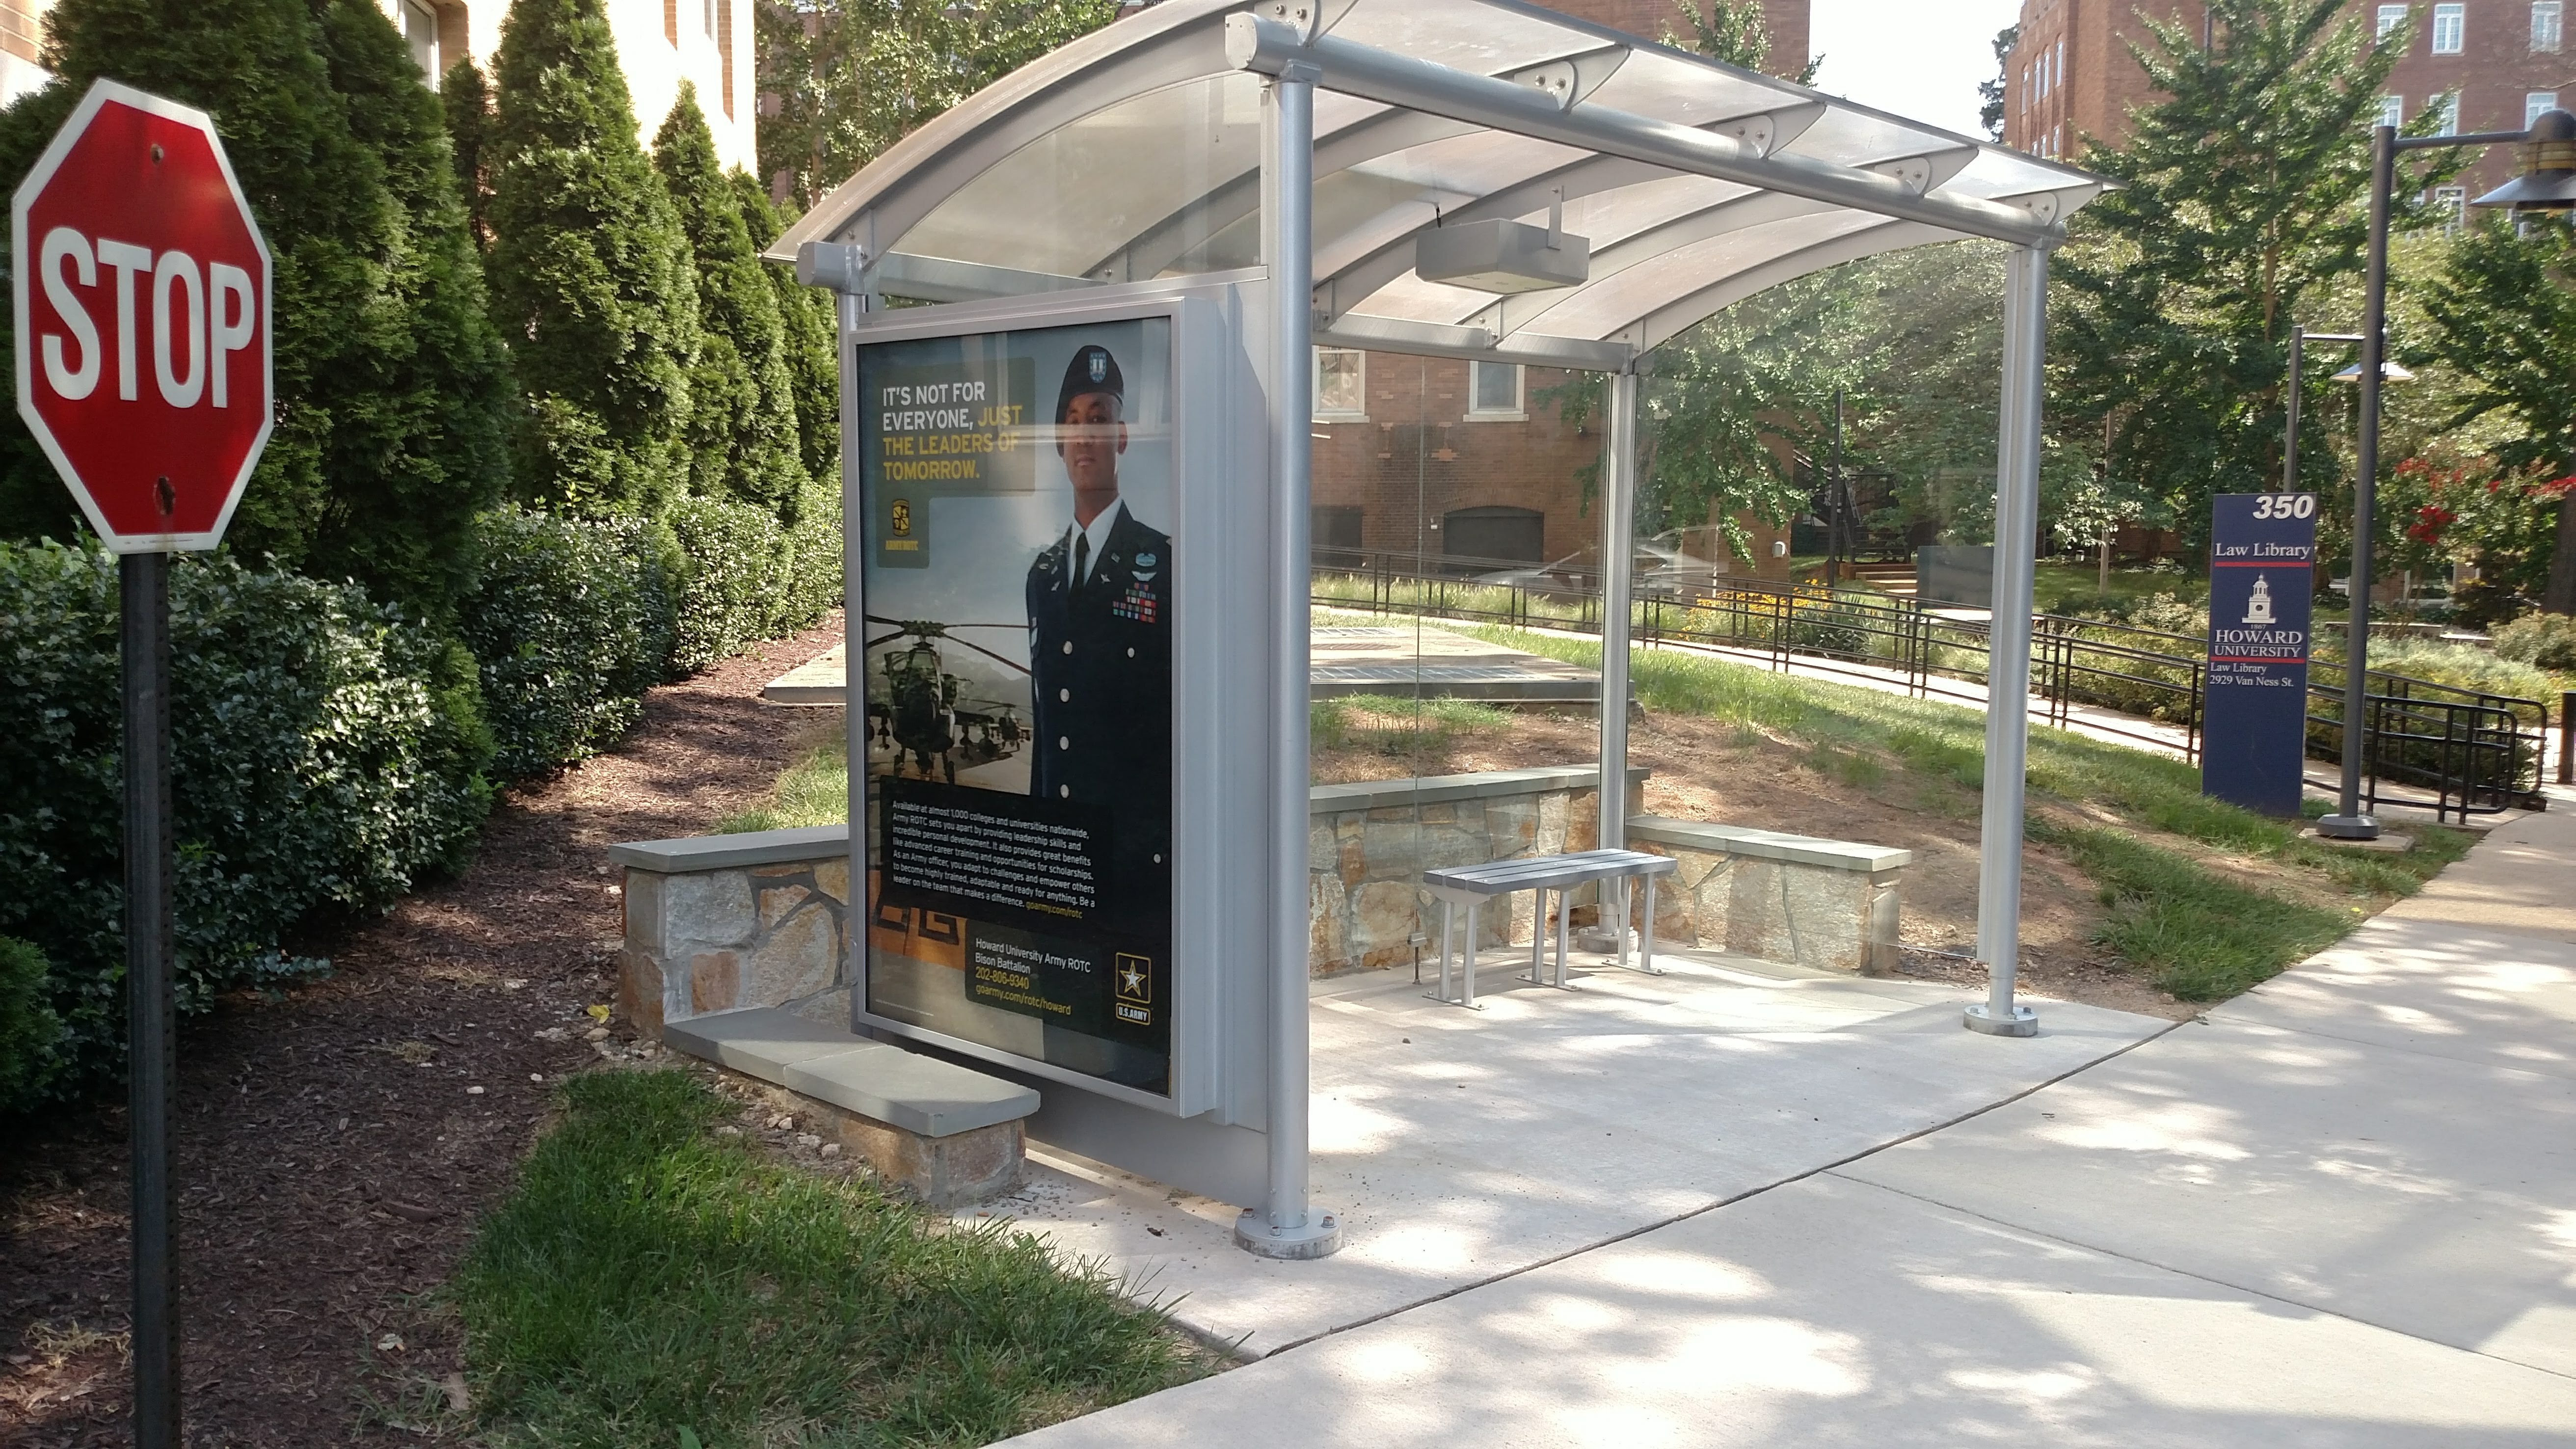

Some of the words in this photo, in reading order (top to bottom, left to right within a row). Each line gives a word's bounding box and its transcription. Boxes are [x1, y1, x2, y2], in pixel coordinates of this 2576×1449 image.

[41, 226, 256, 408] STOP
[884, 387, 911, 406] IT'S
[916, 384, 948, 404] NOT
[953, 381, 985, 402] FOR
[884, 408, 973, 431] EVERYONE,
[978, 405, 1022, 427] JUST
[883, 436, 914, 456] THE
[919, 433, 993, 455] LEADERS
[998, 432, 1020, 452] OF
[884, 460, 980, 481] TOMORROW.
[2253, 495, 2313, 519] 350
[2215, 543, 2249, 556] Law
[2253, 543, 2311, 560] Library
[2215, 629, 2303, 644] HOWARD
[2215, 645, 2301, 658] UNIVERSITY
[2209, 675, 2232, 685] 2929
[2235, 676, 2253, 685] Van
[2256, 677, 2279, 686] Ness
[2281, 677, 2294, 687] St.
[2210, 662, 2230, 672] Law
[2233, 663, 2267, 675] Library
[893, 800, 920, 812] Available
[929, 806, 950, 817] almost
[951, 809, 968, 819] 1,000
[970, 813, 995, 824] colleges
[996, 817, 1008, 826] and
[1010, 819, 1048, 832] universities
[1049, 826, 1089, 840] nationwide,
[893, 813, 908, 824] Army
[910, 815, 927, 826] ROTC
[929, 819, 942, 828] sets
[943, 822, 955, 831] you
[957, 824, 972, 833] apart
[974, 826, 982, 836] by
[983, 828, 1012, 841] providing
[1014, 832, 1047, 846] leadership
[1049, 838, 1067, 848] skills
[1068, 842, 1081, 851] and
[893, 825, 921, 837] incredible
[923, 832, 949, 842] personal
[950, 835, 992, 849] development.
[993, 841, 997, 850] It
[999, 843, 1012, 852] also
[1014, 847, 1041, 858] provides
[1043, 851, 1061, 861] great
[1063, 853, 1091, 866] benefits
[893, 837, 903, 847] like
[905, 839, 933, 852] advanced
[934, 845, 953, 855] career
[955, 848, 979, 861] training
[980, 853, 992, 862] and
[993, 856, 1036, 870] opportunities
[1038, 862, 1047, 871] for
[1049, 865, 1094, 880] scholarships.
[893, 850, 901, 859] As
[911, 853, 927, 864] Army
[929, 856, 949, 867] officer,
[964, 863, 981, 873] adapt
[982, 866, 989, 874] to
[991, 868, 1024, 882] challenges
[1025, 875, 1038, 883] and
[1040, 877, 1071, 889] empower
[1072, 883, 1095, 893] others
[893, 862, 899, 870] to
[901, 863, 923, 875] become
[925, 868, 943, 880] highly
[944, 871, 968, 884] trained,
[970, 877, 1000, 889] adaptable
[1015, 886, 1034, 897] ready
[1035, 888, 1046, 897] for
[1047, 892, 1078, 906] anything.
[1079, 897, 1089, 906] Be
[893, 874, 911, 884] leader
[922, 880, 932, 889] the
[933, 882, 949, 892] team
[950, 885, 963, 895] that
[965, 888, 984, 899] makes
[992, 892, 1024, 907] difference.
[1026, 900, 1083, 919] goarmy.com/rotc
[975, 952, 995, 966] Bison
[997, 957, 1030, 974] Battalion
[976, 938, 1004, 953] Howard
[1006, 944, 1043, 964] University
[1045, 953, 1066, 969] Army
[1068, 958, 1091, 973] ROTC
[975, 966, 1029, 990] 202-806-9340
[976, 984, 1071, 1015] goarmy.com/rotc/howard
